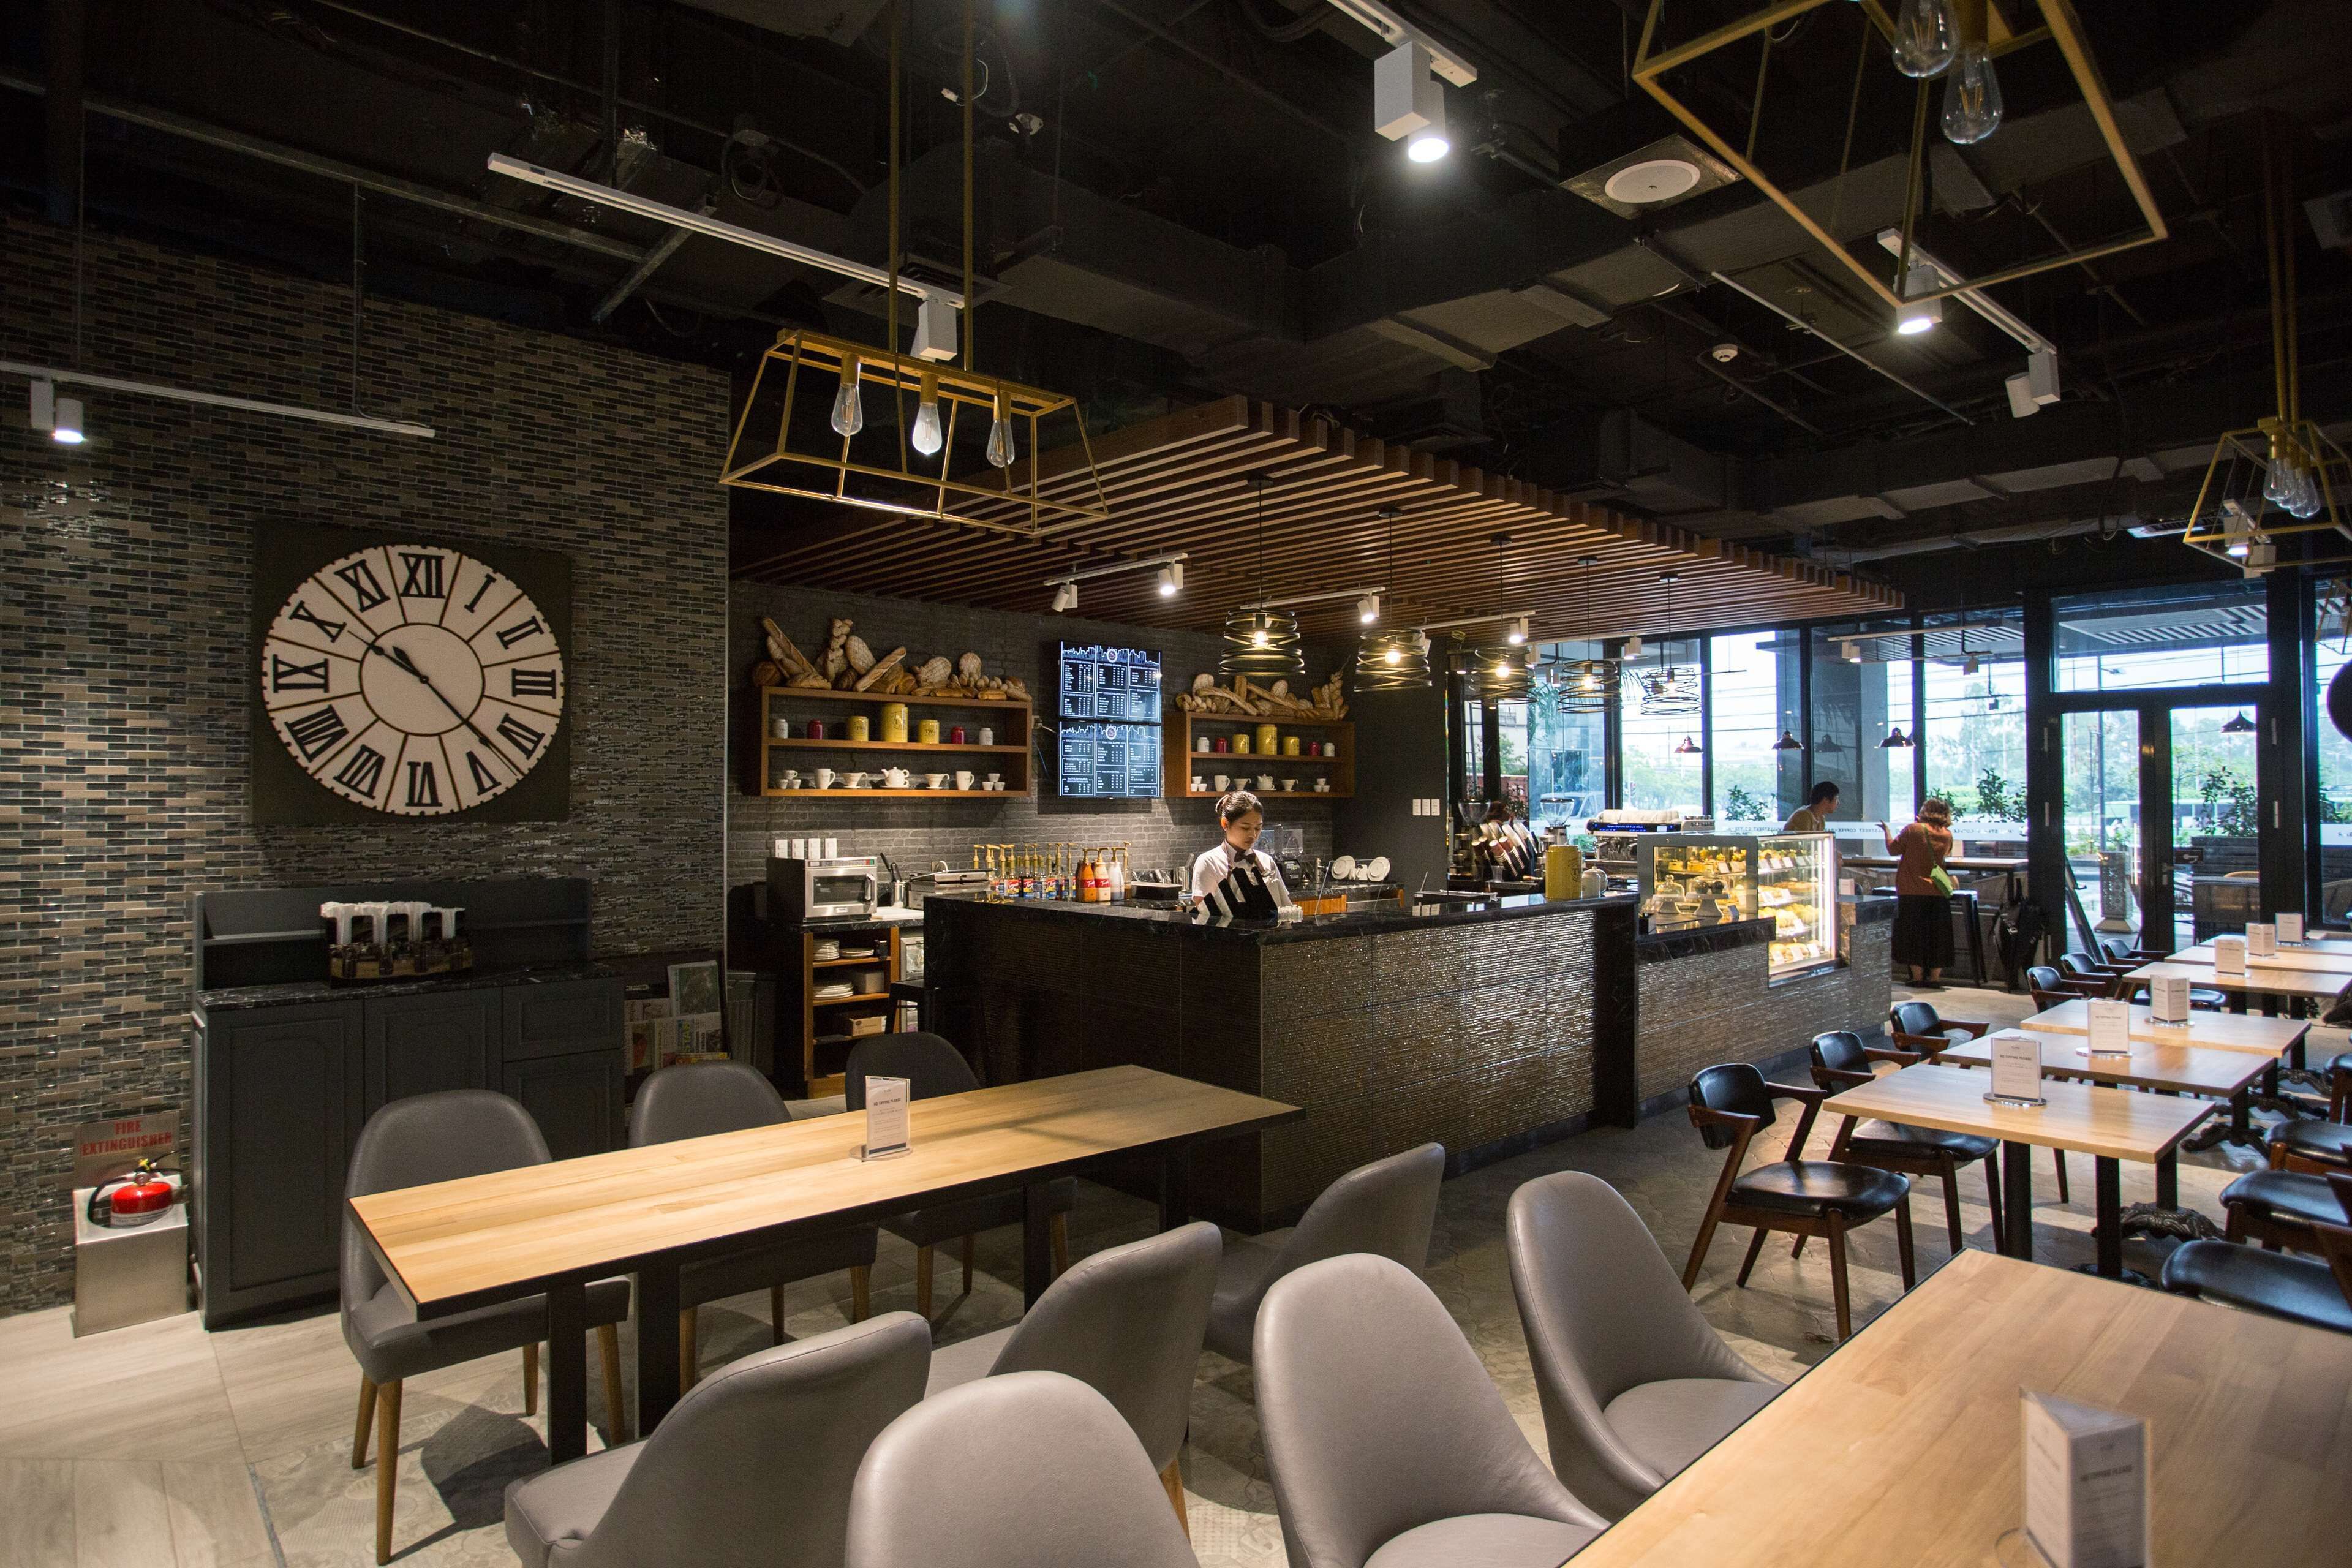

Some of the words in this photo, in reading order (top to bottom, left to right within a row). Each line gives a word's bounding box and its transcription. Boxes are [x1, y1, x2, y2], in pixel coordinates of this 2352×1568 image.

[334, 559, 391, 613] XI
[398, 552, 445, 599] XII
[464, 574, 496, 613] I
[289, 600, 347, 643] X
[496, 616, 544, 649] II
[273, 654, 329, 693] IX
[511, 668, 556, 699] III
[284, 704, 349, 762] VIII
[496, 712, 545, 760] IV
[333, 744, 386, 799] VII
[405, 761, 442, 807] VI
[466, 750, 502, 796] V
[82, 1131, 172, 1156] EXTINGUISHER
[115, 1120, 142, 1134] FIRE
